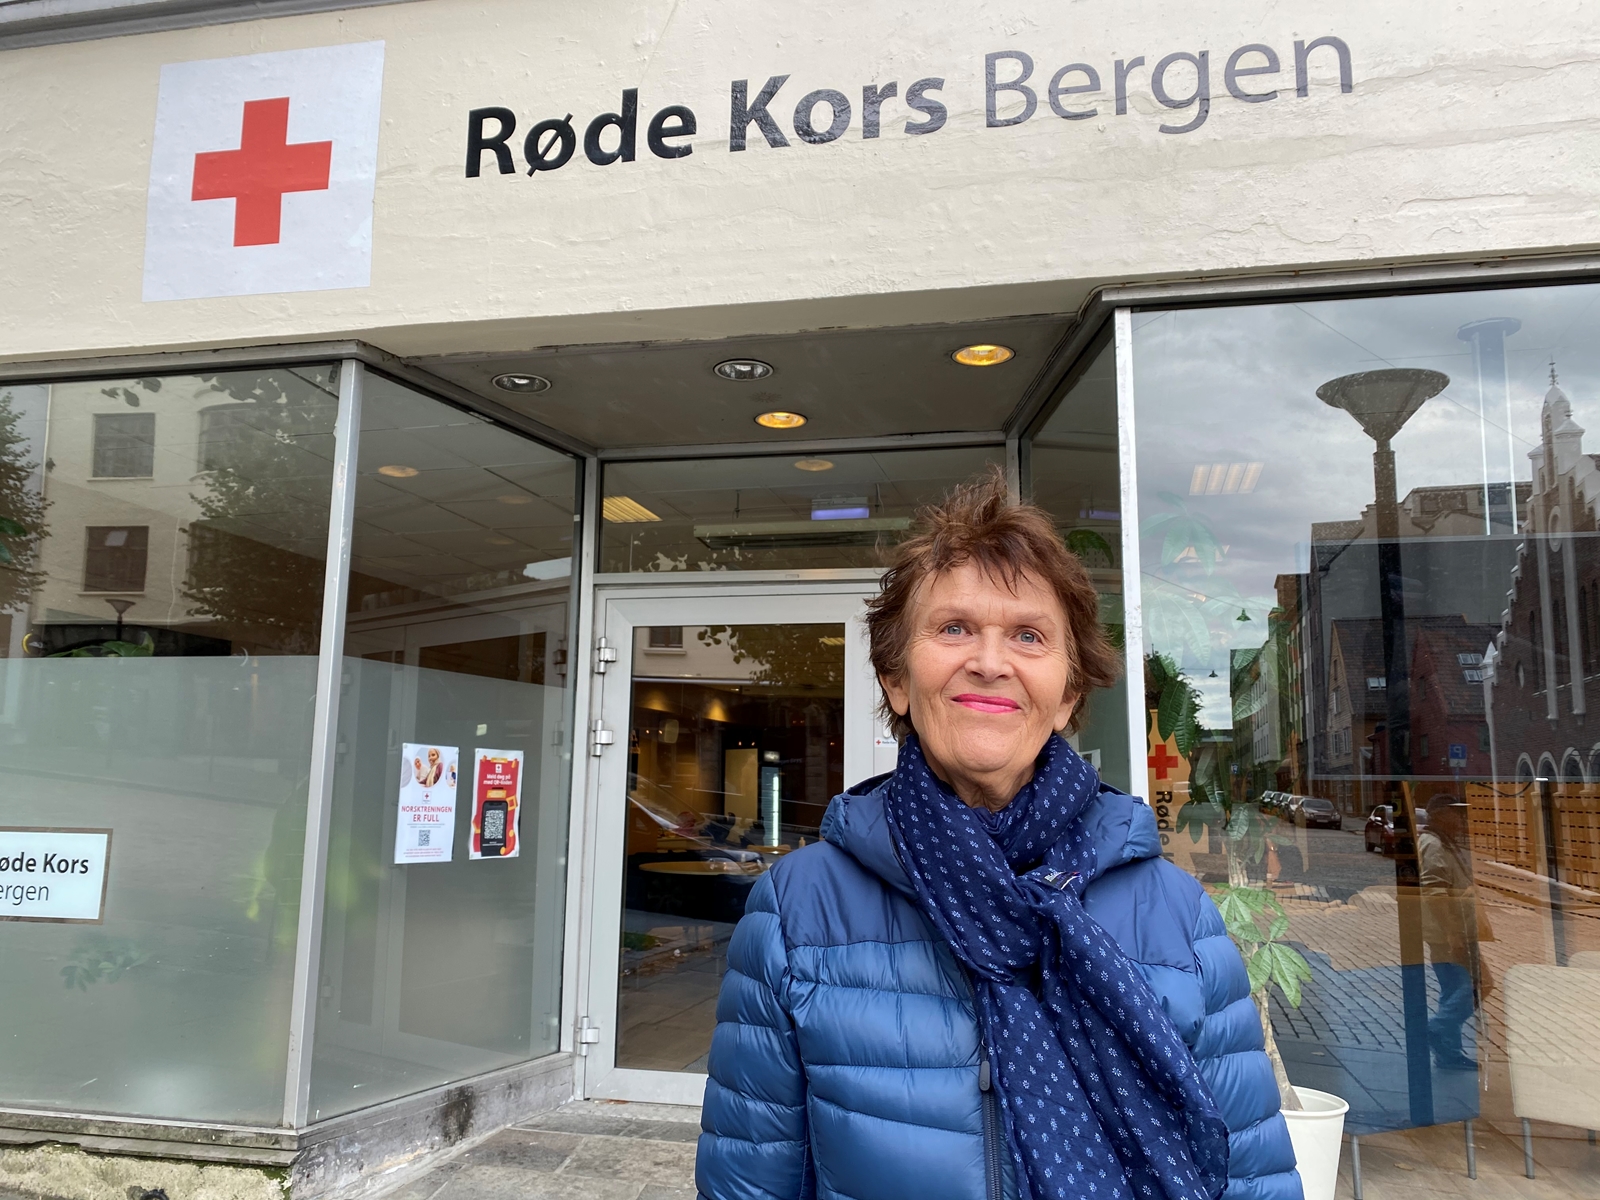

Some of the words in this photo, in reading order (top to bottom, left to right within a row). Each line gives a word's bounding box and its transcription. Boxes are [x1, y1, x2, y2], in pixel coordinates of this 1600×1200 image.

[465, 87, 697, 178] Røde
[729, 74, 948, 153] Kors
[985, 35, 1353, 134] Bergen
[401, 805, 452, 813] NORSKTRENINGEN
[413, 814, 421, 822] ER
[423, 814, 439, 822] FULL
[1156, 791, 1174, 846] Røde
[0, 851, 37, 872] øde
[43, 853, 89, 874] Kors
